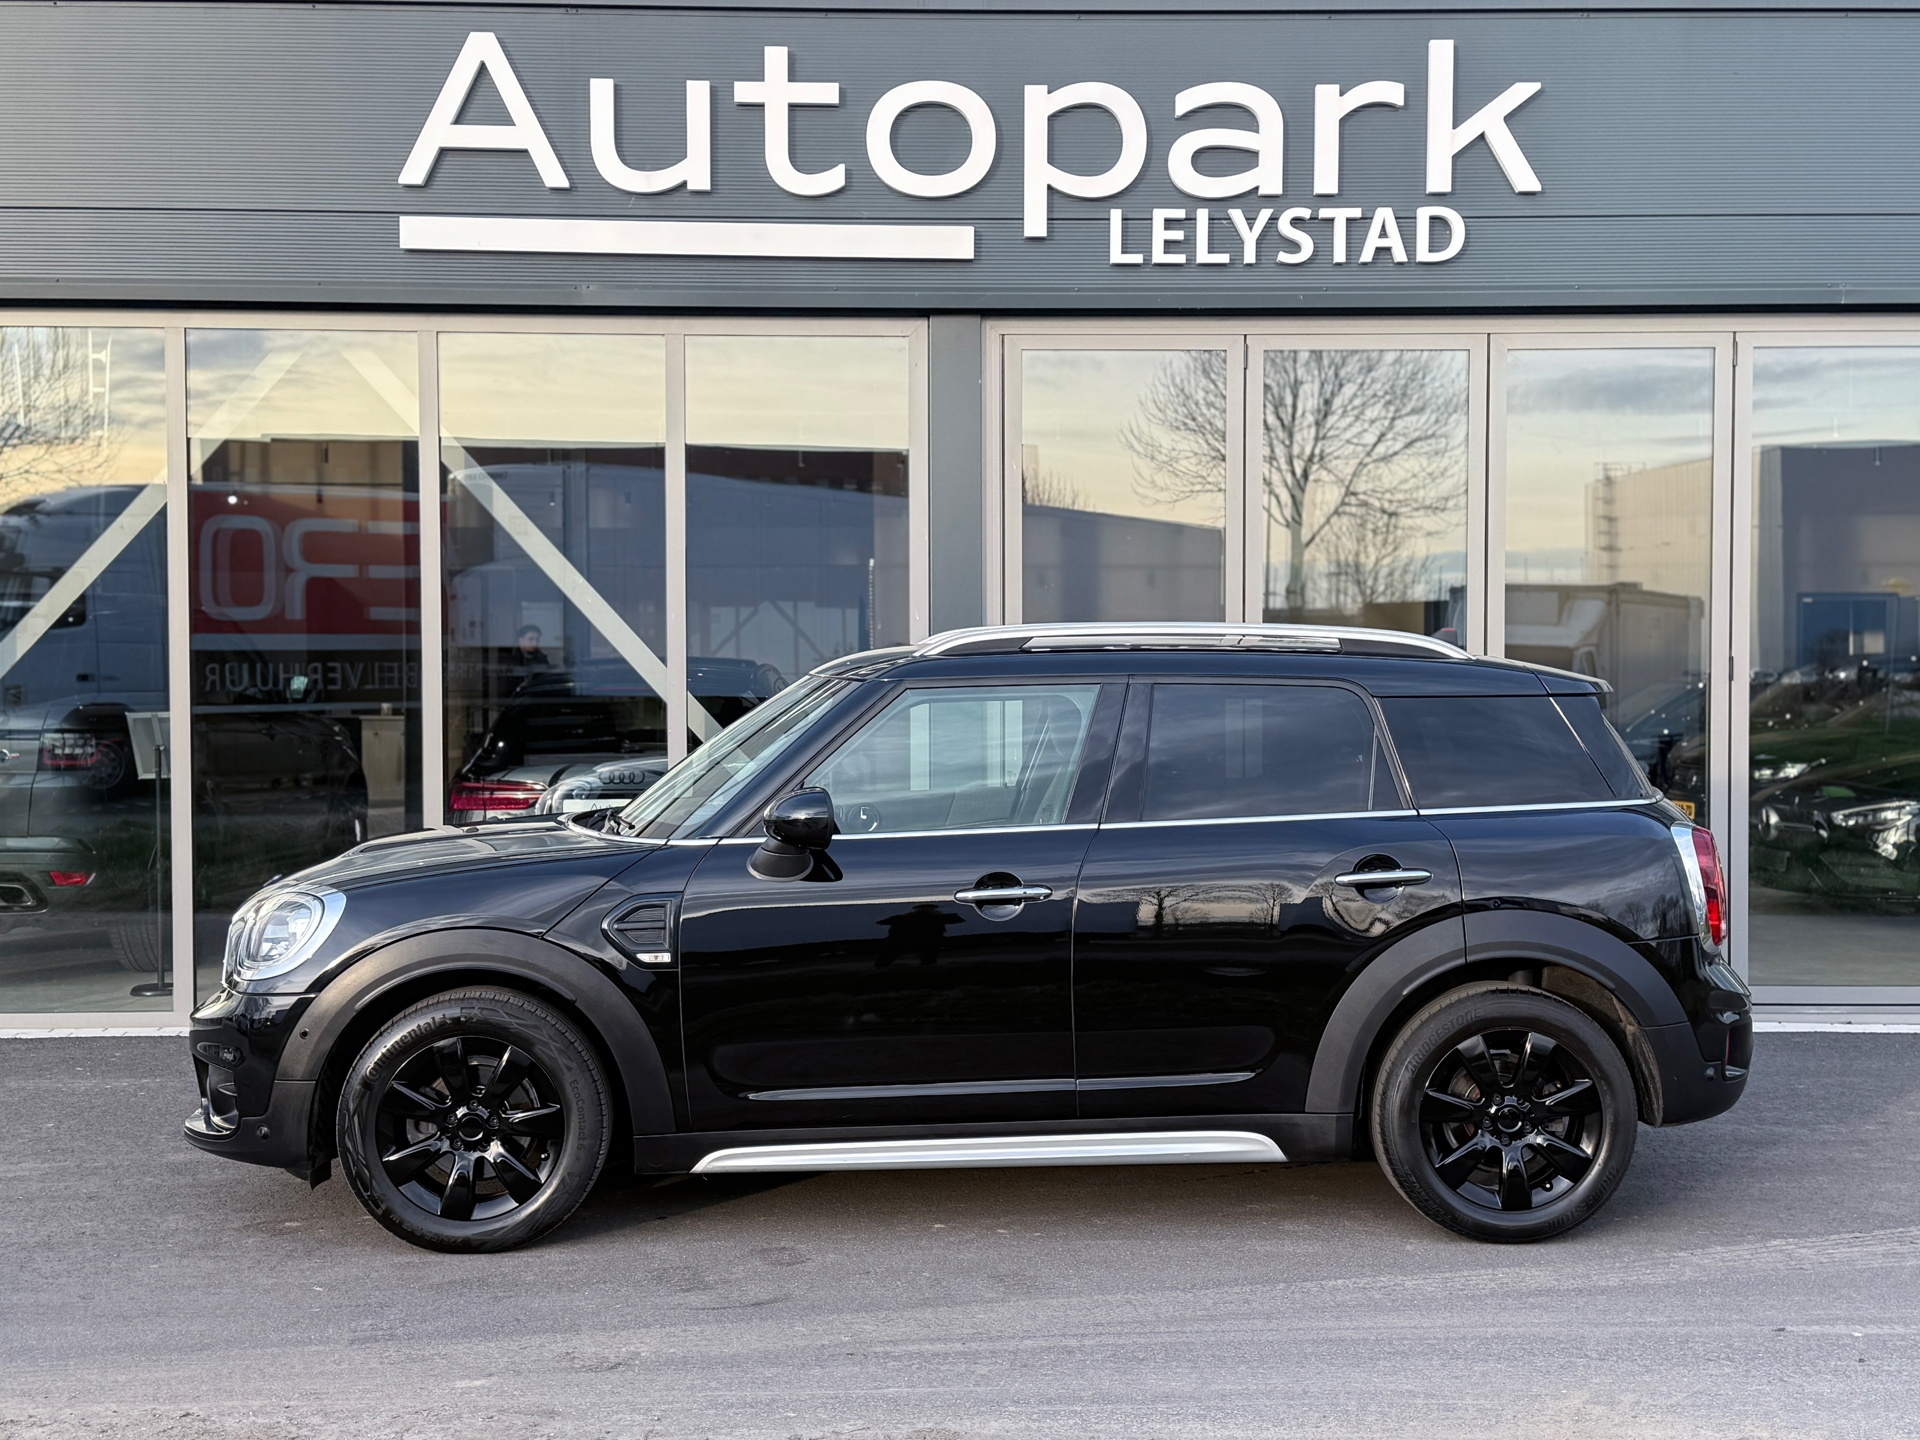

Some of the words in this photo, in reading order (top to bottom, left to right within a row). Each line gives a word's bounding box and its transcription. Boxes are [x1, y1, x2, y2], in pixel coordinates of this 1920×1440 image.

[398, 32, 1542, 238] Autopark
[1109, 206, 1466, 266] LELYSTAD
[364, 1016, 438, 1083] Continental
[1405, 1007, 1483, 1076] BRIDGESTONE
[569, 1079, 587, 1141] EcoContact
[577, 1143, 587, 1151] 6
